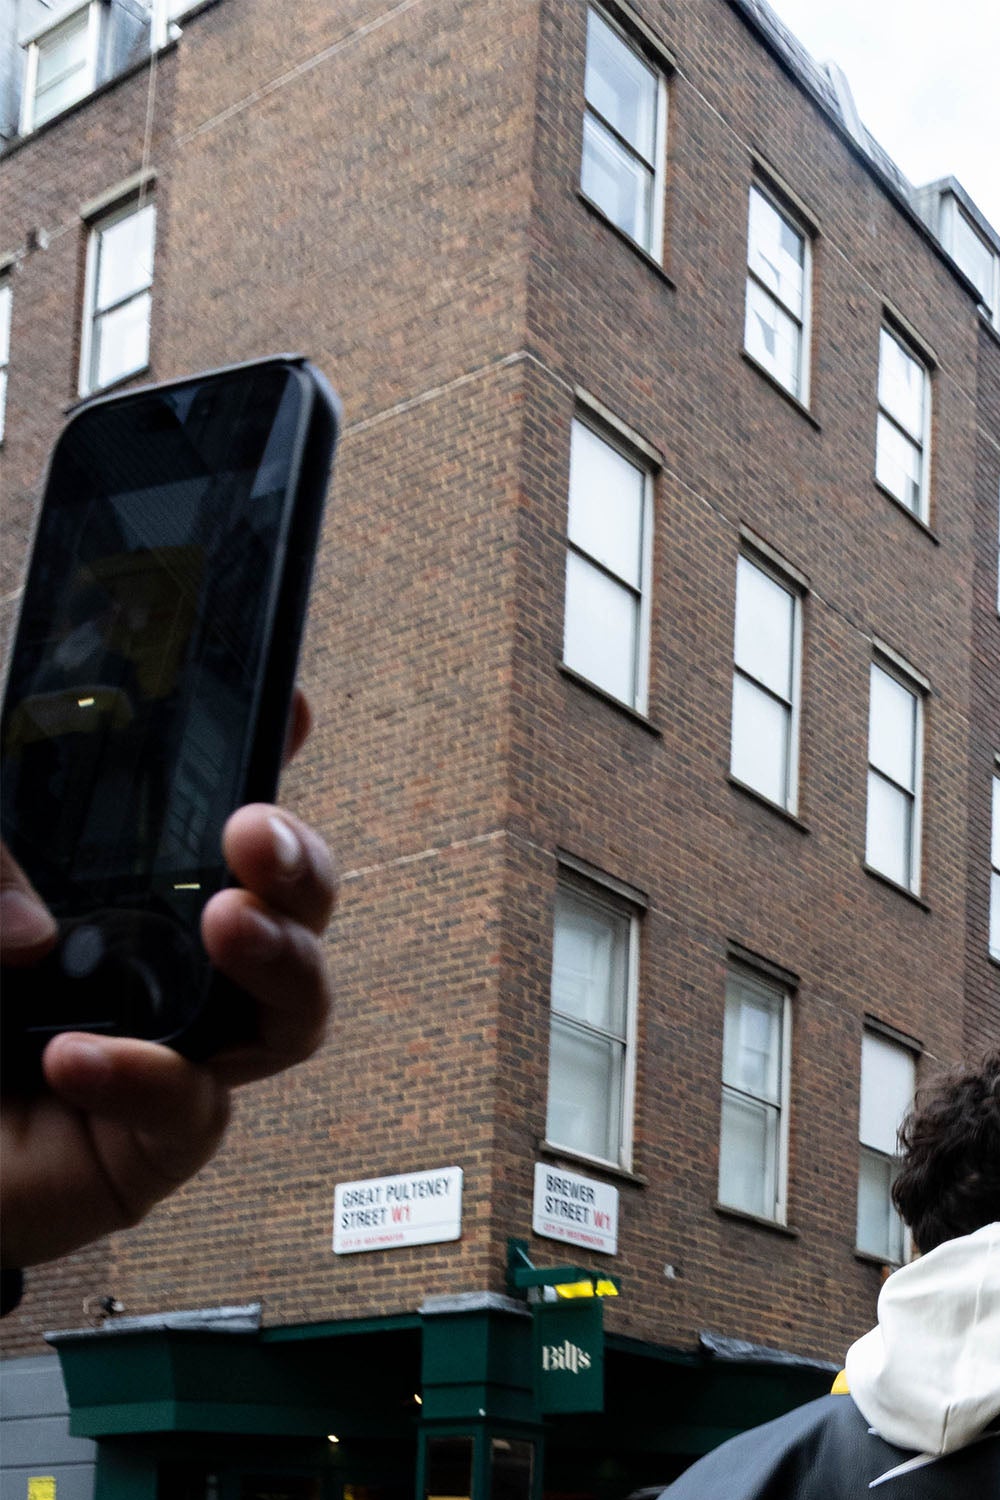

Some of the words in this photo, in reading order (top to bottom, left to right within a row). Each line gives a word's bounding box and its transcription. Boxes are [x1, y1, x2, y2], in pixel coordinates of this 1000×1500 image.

[342, 1186, 382, 1208] GREAT
[386, 1176, 451, 1202] PULTENEY
[546, 1174, 596, 1205] BREWER
[341, 1206, 387, 1229] STREET
[392, 1205, 410, 1223] W1
[545, 1195, 589, 1224] STREET
[593, 1209, 611, 1232] W1
